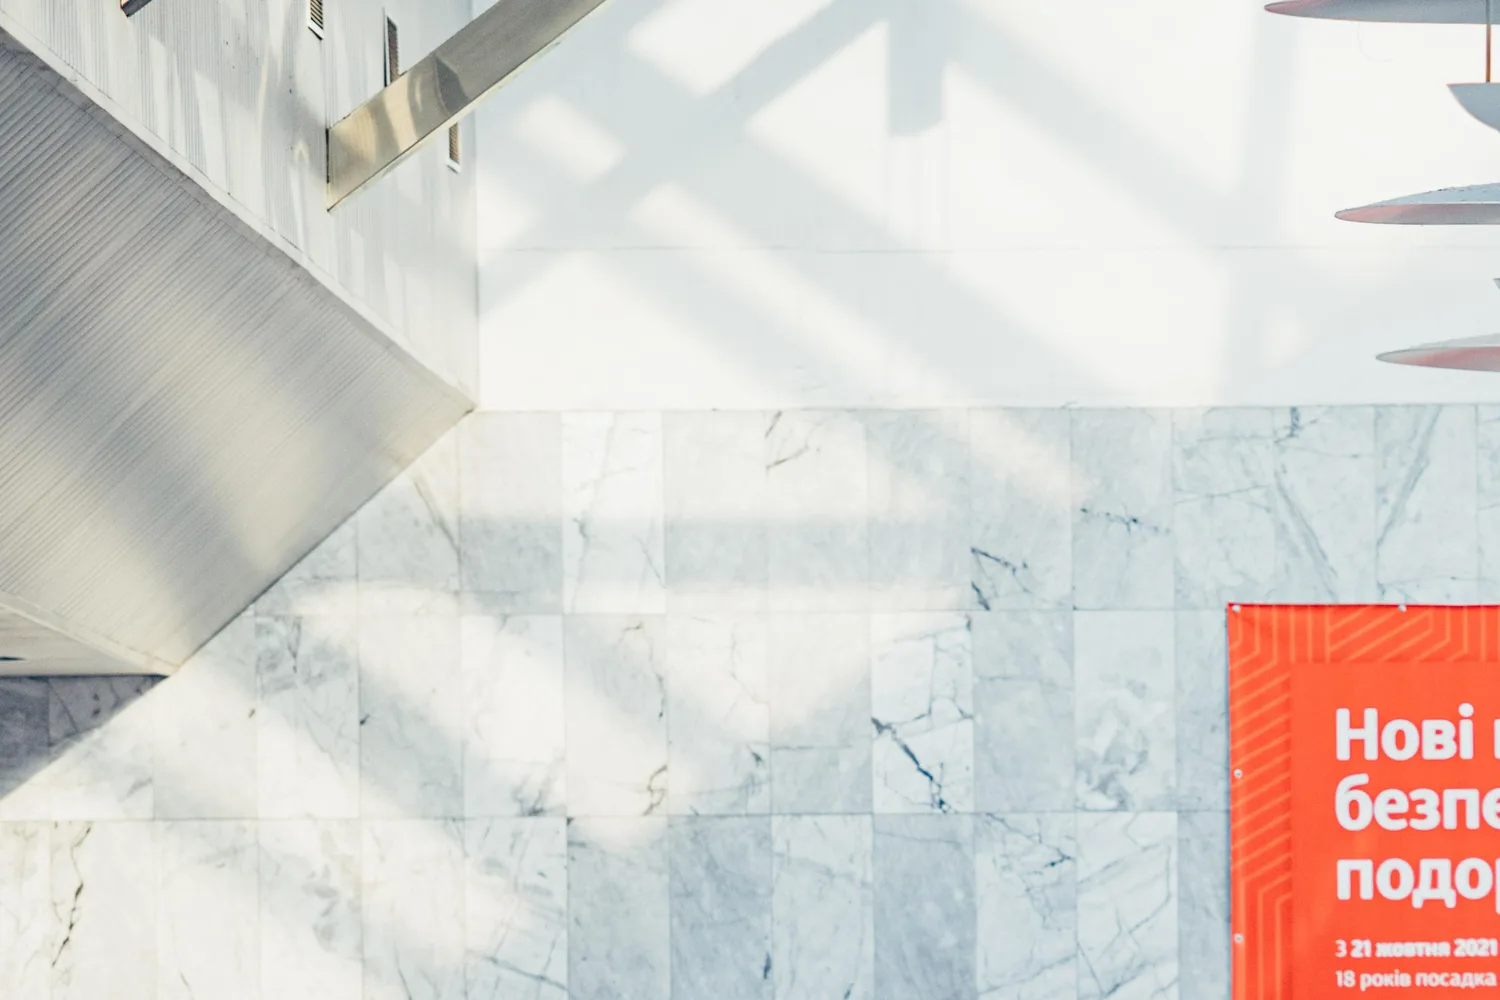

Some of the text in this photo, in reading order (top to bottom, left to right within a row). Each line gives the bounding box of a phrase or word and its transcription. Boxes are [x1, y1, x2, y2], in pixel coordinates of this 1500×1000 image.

[1335, 703, 1474, 760] Нові
[1351, 941, 1371, 957] 21
[1375, 942, 1449, 957] жовтня
[1454, 939, 1497, 956] 2021
[1336, 971, 1355, 987] 18
[1360, 971, 1410, 990] років
[1416, 972, 1496, 988] посадка
